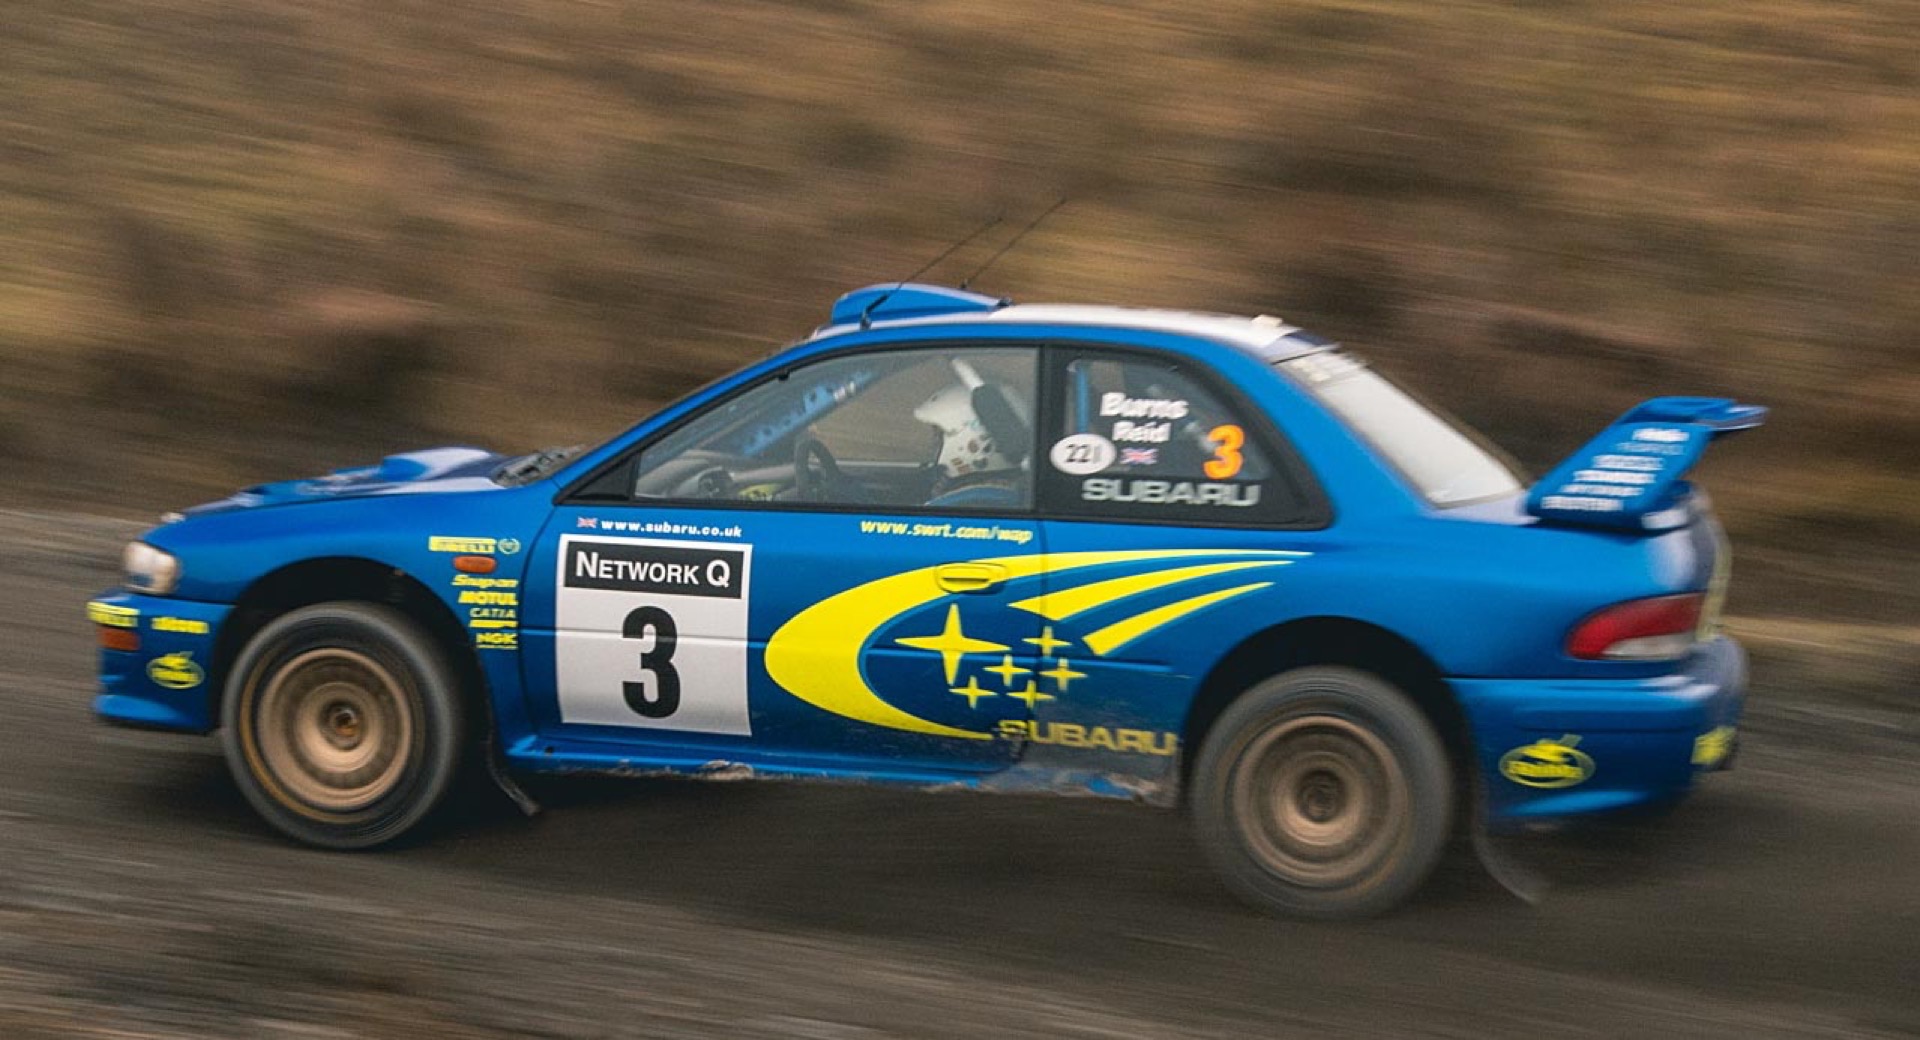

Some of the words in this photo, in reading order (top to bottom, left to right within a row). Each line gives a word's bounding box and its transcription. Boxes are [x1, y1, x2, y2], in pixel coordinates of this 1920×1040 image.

[1112, 421, 1171, 442] Reid
[1203, 424, 1244, 479] 3
[1081, 478, 1262, 507] SUBARU
[601, 520, 742, 537] www.subaru.co.uk
[706, 559, 731, 588] Q
[458, 590, 519, 606] MOTUL
[622, 605, 681, 719] 3
[998, 719, 1178, 756] SUBARU
